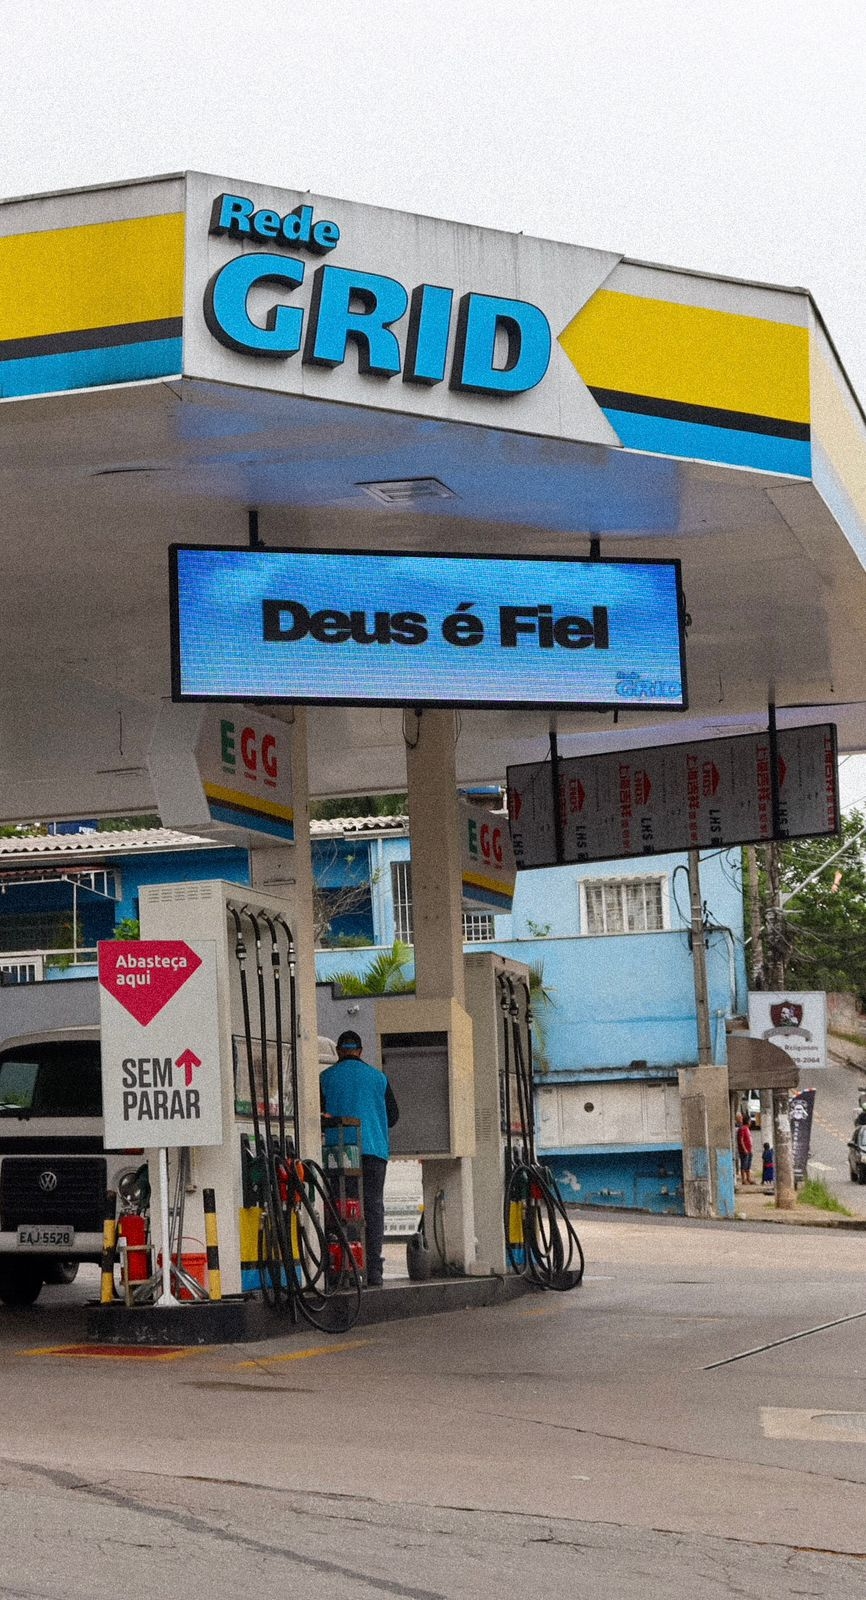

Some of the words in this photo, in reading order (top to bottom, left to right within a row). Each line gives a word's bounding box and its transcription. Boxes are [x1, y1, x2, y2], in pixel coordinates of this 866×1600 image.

[210, 193, 341, 254] Rede
[204, 252, 551, 394] GRID
[262, 599, 429, 645] Deus
[442, 603, 484, 647] é
[500, 605, 609, 649] Fiel
[641, 817, 653, 841] LHS
[709, 808, 721, 833] LHS
[575, 825, 587, 848] LHS
[115, 954, 188, 971] Abasteça
[116, 970, 151, 988] aqui
[121, 1058, 173, 1089] SEM
[123, 1089, 200, 1121] PARAR
